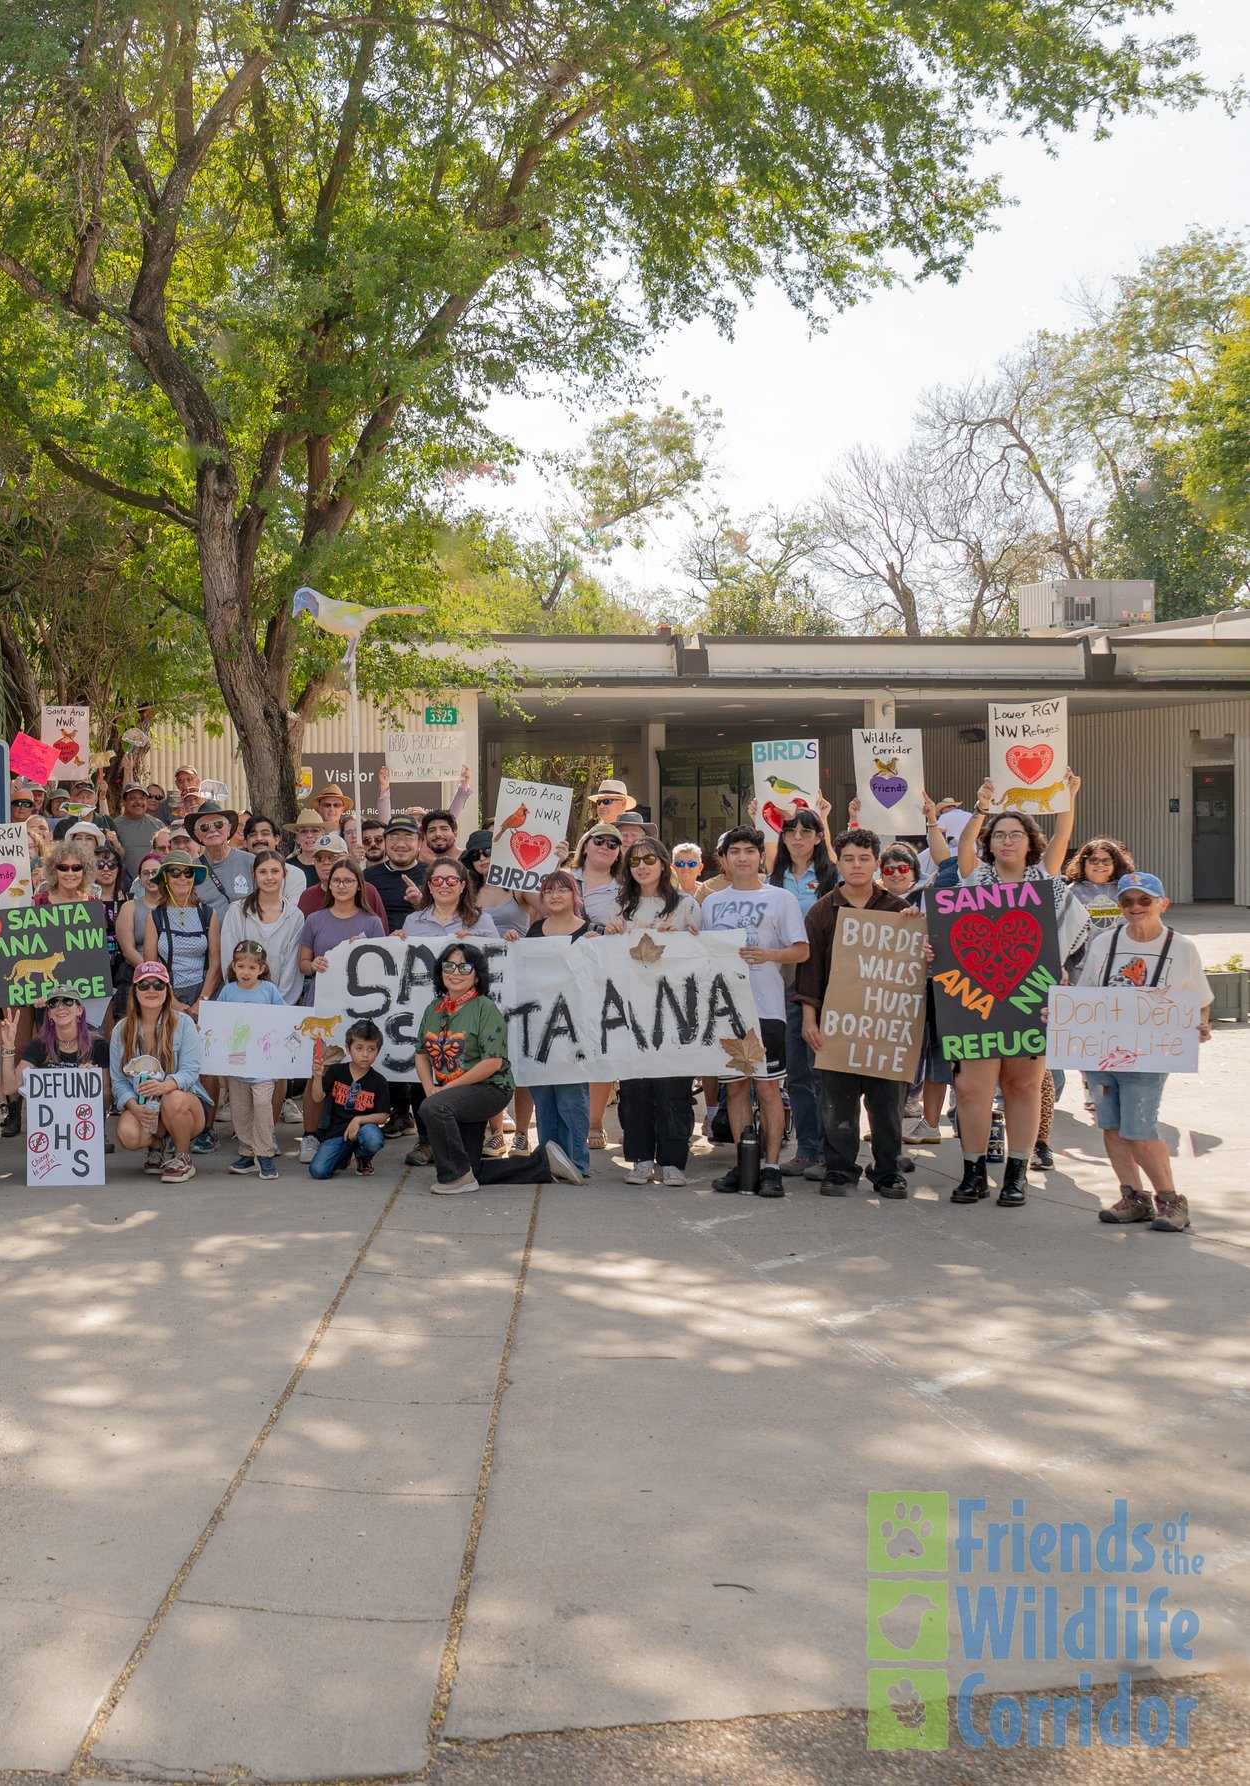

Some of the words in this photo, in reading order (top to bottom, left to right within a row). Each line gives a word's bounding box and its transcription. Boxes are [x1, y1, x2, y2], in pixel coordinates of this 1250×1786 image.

[45, 707, 67, 715] Santa
[70, 708, 85, 717] Ana
[994, 707, 1027, 720] Lower
[1031, 701, 1059, 716] RGV
[56, 717, 75, 727] NWR
[995, 725, 1018, 738] NW
[388, 733, 409, 752] NO
[412, 734, 461, 750] BORDER
[861, 731, 903, 744] Wildlife
[403, 753, 441, 764] WALL
[753, 740, 817, 763] BIRDS
[872, 746, 913, 755] Corridor
[325, 770, 374, 783] Visior
[506, 781, 537, 796] Santa
[540, 788, 563, 801] Ana
[872, 783, 907, 793] Friends
[535, 808, 561, 826] NWR
[935, 881, 1042, 915] SANTA
[7, 903, 91, 930] SANTA
[65, 927, 104, 951] NW
[858, 954, 921, 987] WALLS
[932, 969, 995, 1020] ANA
[1009, 964, 1058, 1016] NW
[864, 986, 923, 1019] HURT
[1054, 993, 1123, 1026] Don't
[1137, 996, 1195, 1029] Deny
[601, 973, 747, 1055] ANA
[941, 1028, 1047, 1061] REFUG
[1050, 1029, 1119, 1058] Their
[1136, 1032, 1184, 1057] Life
[30, 1072, 102, 1098] DEFUND
[31, 1153, 50, 1168] Chinga
